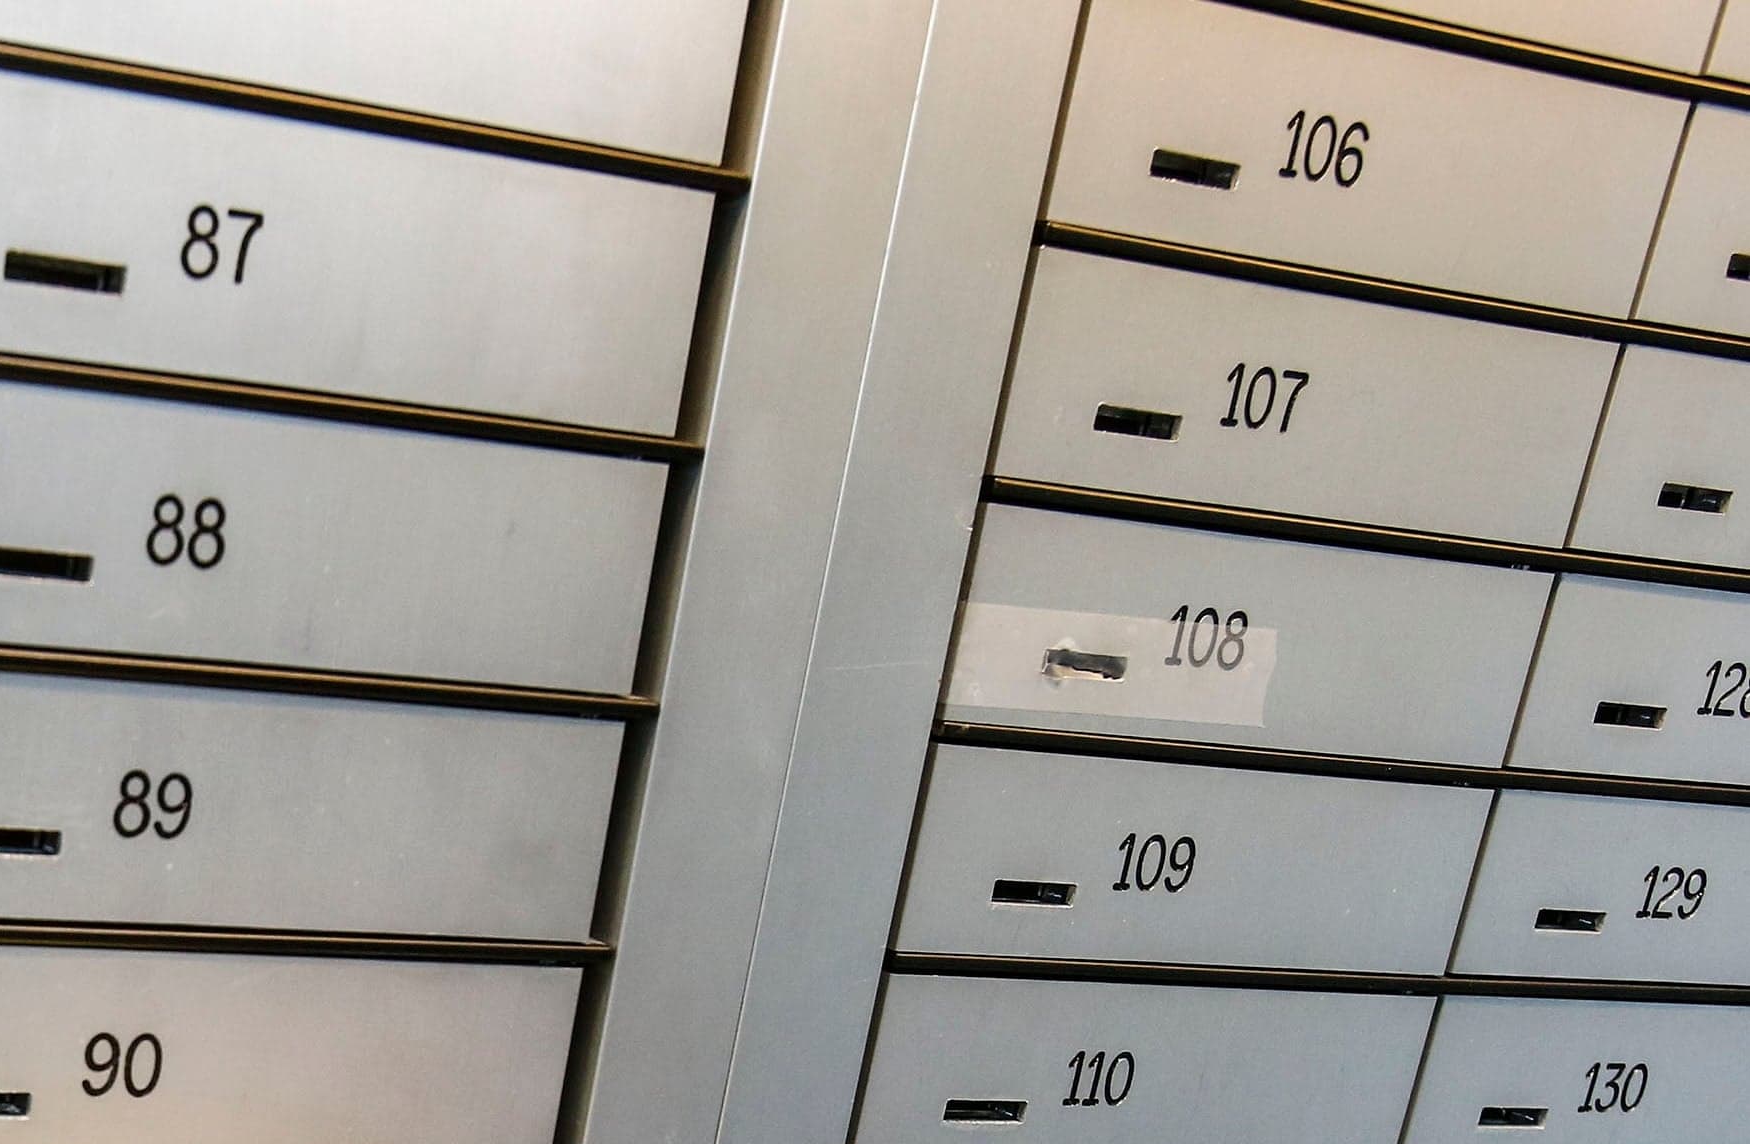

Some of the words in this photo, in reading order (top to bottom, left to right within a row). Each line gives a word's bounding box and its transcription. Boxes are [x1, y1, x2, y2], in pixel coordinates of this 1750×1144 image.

[1278, 110, 1370, 188] 106
[180, 204, 264, 285] 87
[1219, 362, 1310, 434] 107
[146, 493, 226, 571] 88
[1163, 604, 1249, 671] 108
[112, 769, 193, 840] 89
[1112, 832, 1196, 893] 109
[1635, 865, 1708, 920] 129
[81, 1032, 163, 1098] 90
[1062, 1050, 1135, 1107] 110
[1577, 1062, 1649, 1113] 130
